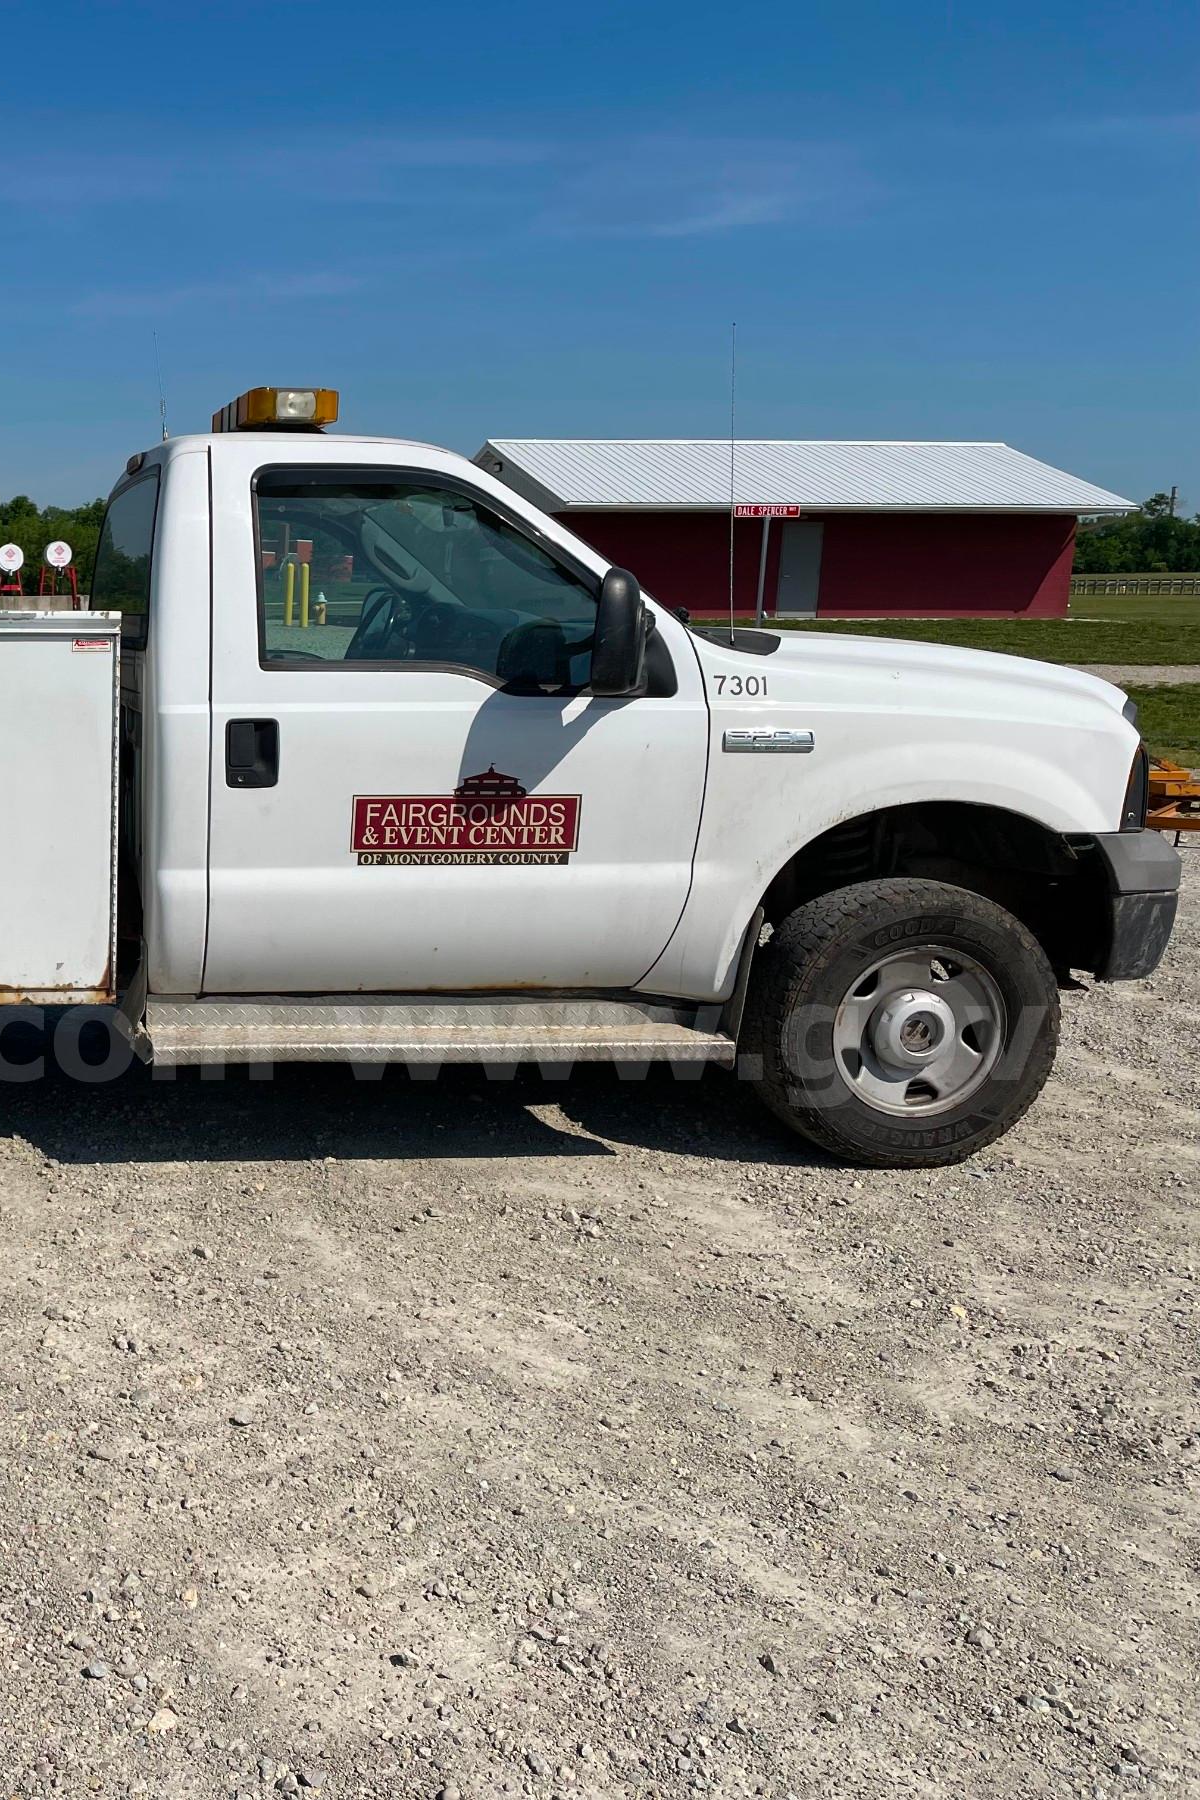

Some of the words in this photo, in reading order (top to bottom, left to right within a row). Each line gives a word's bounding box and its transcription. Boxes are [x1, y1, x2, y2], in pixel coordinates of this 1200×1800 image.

[737, 506, 755, 516] DALE
[758, 506, 788, 516] SPENCER
[713, 675, 768, 696] 7301
[365, 803, 566, 827] FAIRGROUNDS
[361, 826, 379, 846] &
[382, 826, 465, 846] EVENT
[468, 826, 566, 846] CENTER
[360, 853, 383, 865] OF
[384, 853, 498, 865] MONTGOMERY
[498, 852, 564, 865] COUNTY
